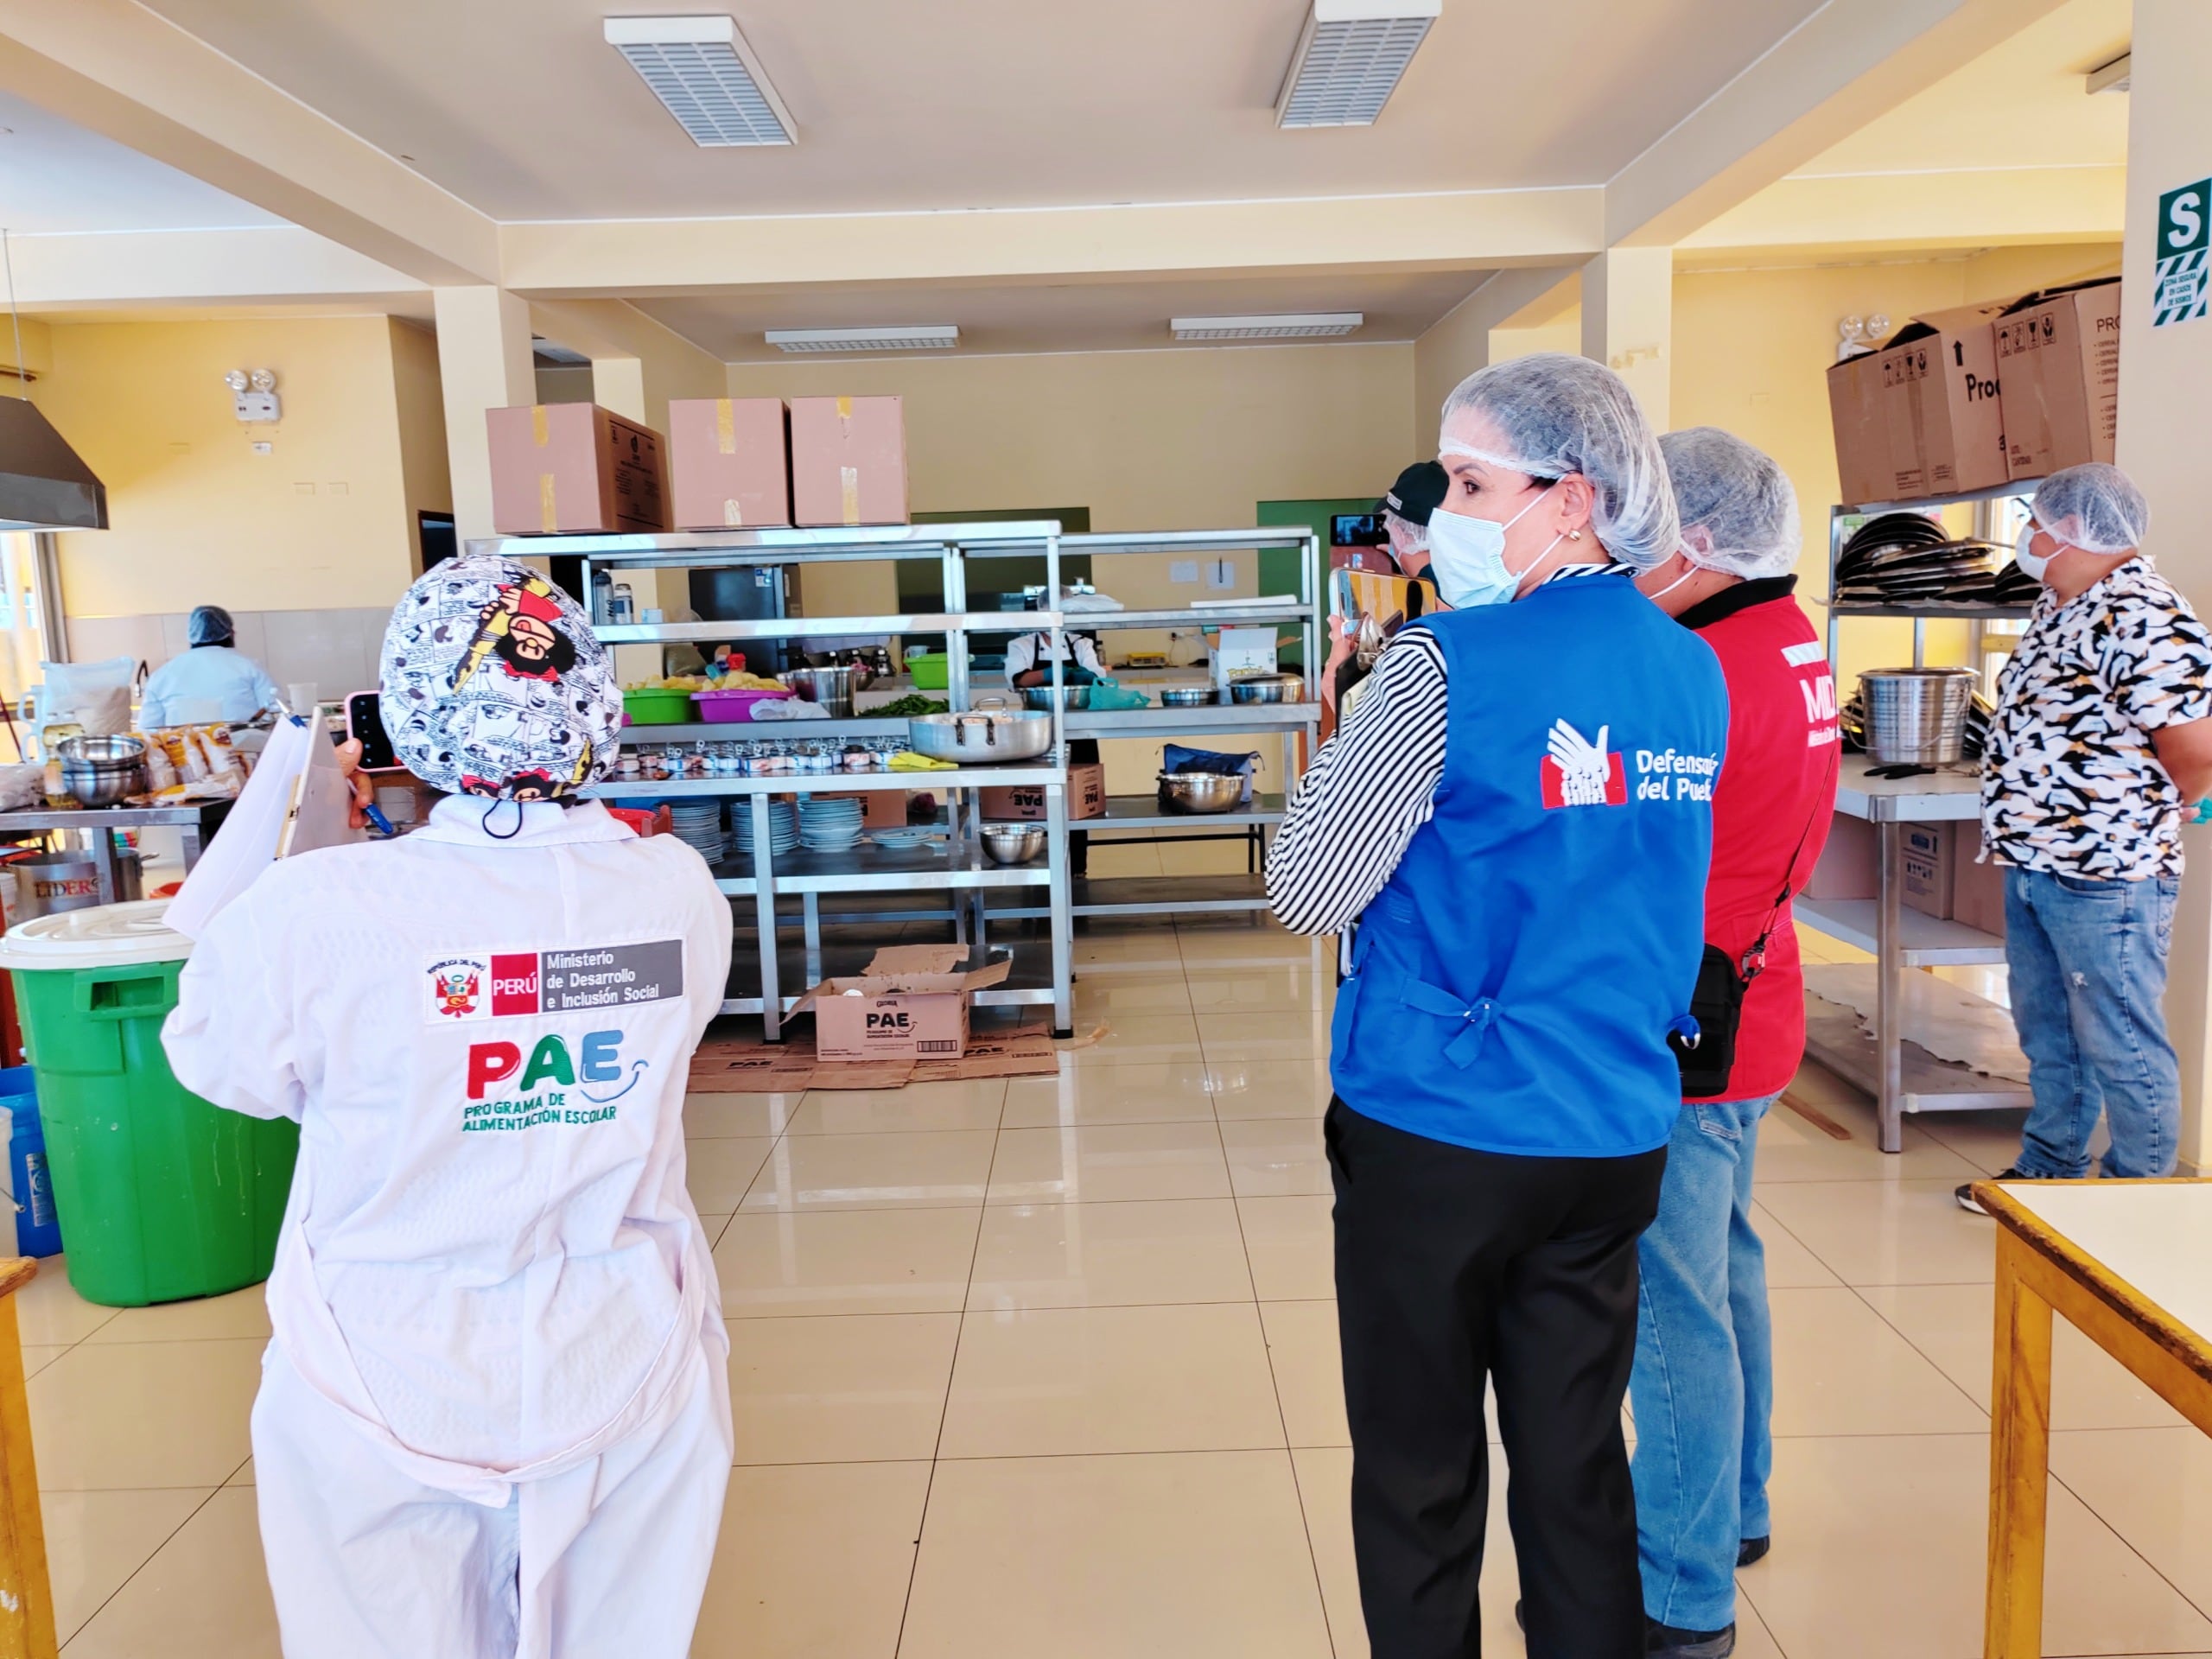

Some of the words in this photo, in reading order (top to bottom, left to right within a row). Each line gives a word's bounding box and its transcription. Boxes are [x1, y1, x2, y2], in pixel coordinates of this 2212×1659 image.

[2168, 192, 2201, 248] S
[1014, 794, 1043, 806] PAE
[1637, 775, 1670, 801] del
[547, 950, 614, 969] Ministerio
[493, 971, 537, 996] PERÚ
[547, 975, 563, 989] de
[569, 969, 636, 988] Desarrollo
[547, 997, 556, 1008] e
[562, 987, 618, 1008] Inclusión
[624, 983, 659, 1002] Social
[866, 1013, 910, 1028] PAE
[467, 1029, 624, 1099] PAE
[464, 1096, 543, 1119] PROGRAMA
[549, 1093, 566, 1106] DE
[462, 1107, 561, 1132] ALIMENTACIÓN
[565, 1106, 617, 1124] ESCOLAR
